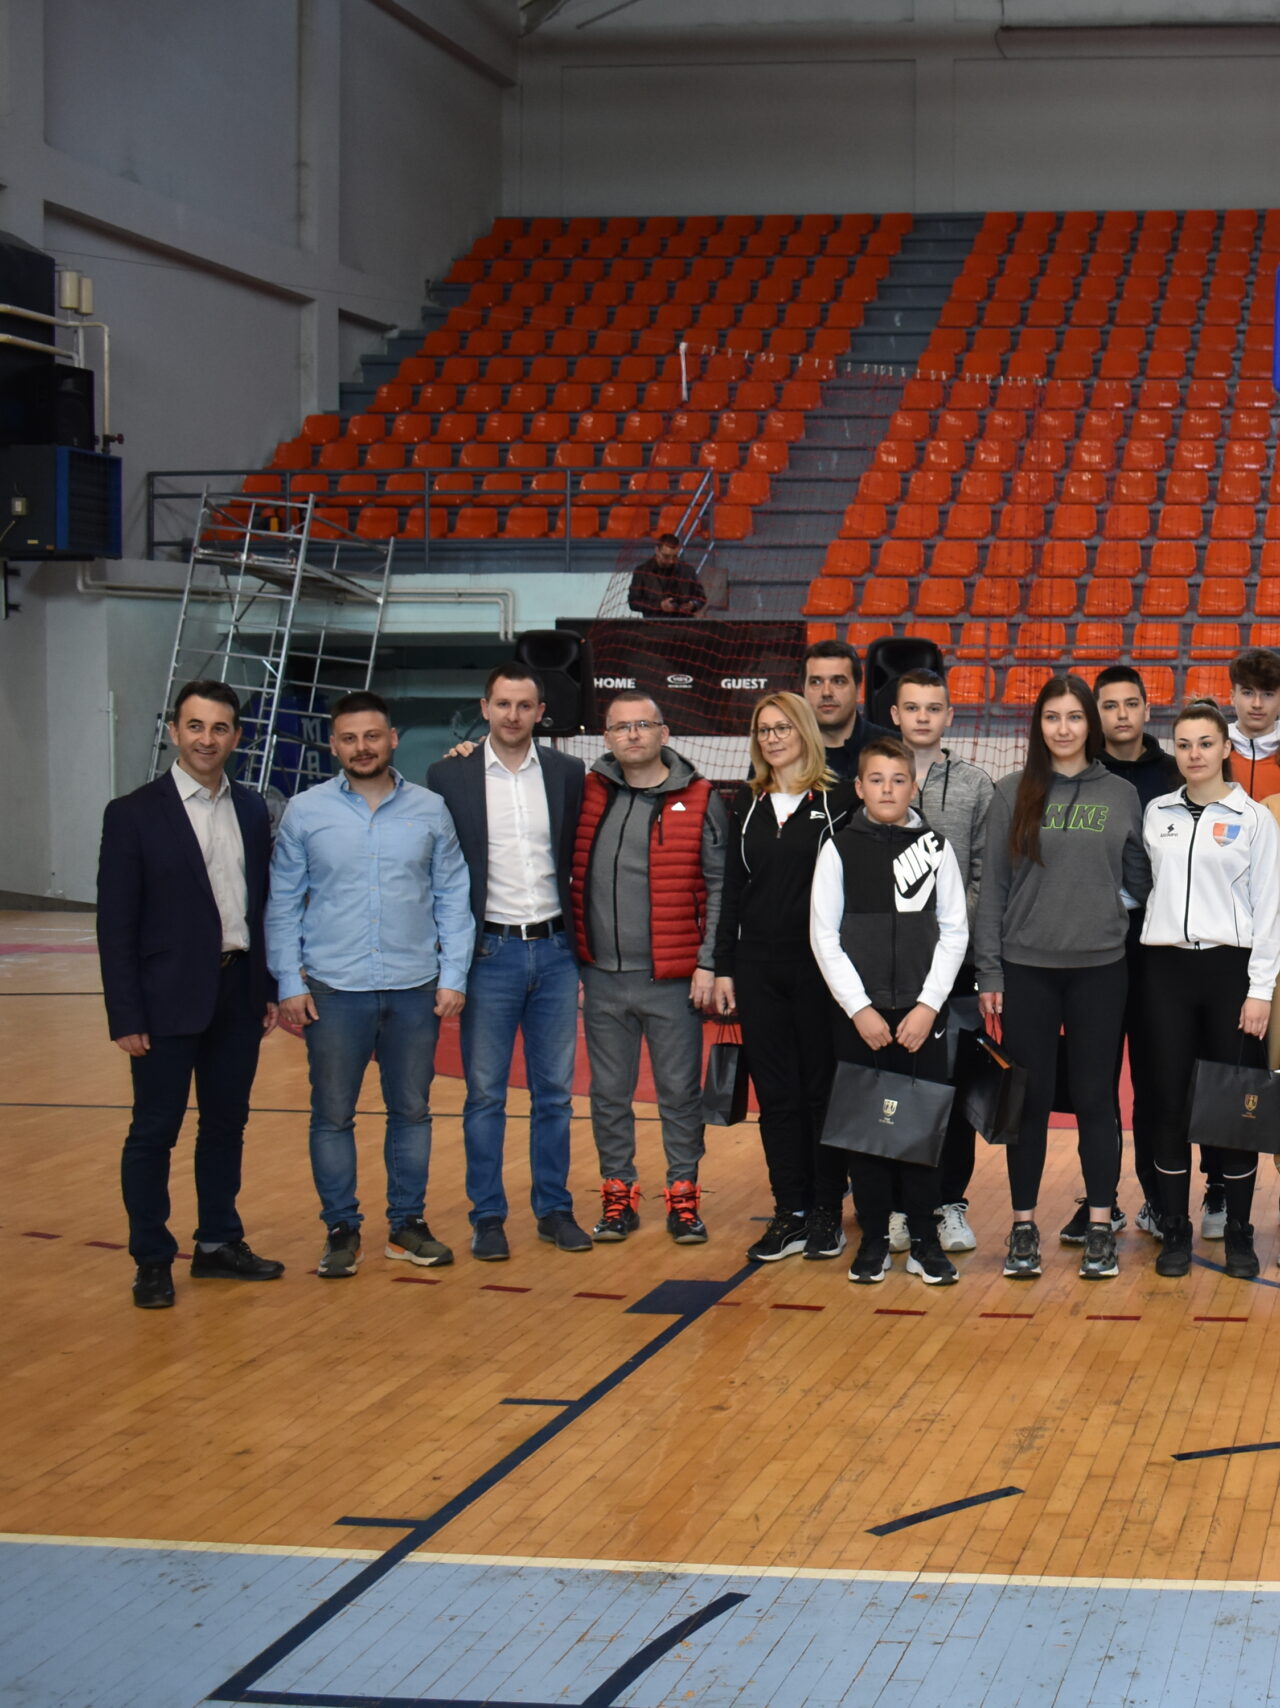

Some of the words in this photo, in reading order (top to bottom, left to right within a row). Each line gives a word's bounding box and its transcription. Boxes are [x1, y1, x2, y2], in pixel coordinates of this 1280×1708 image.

[593, 677, 636, 689] HOME
[720, 678, 768, 690] GUEST
[1041, 803, 1109, 832] NIKE
[893, 831, 943, 895] NIKE
